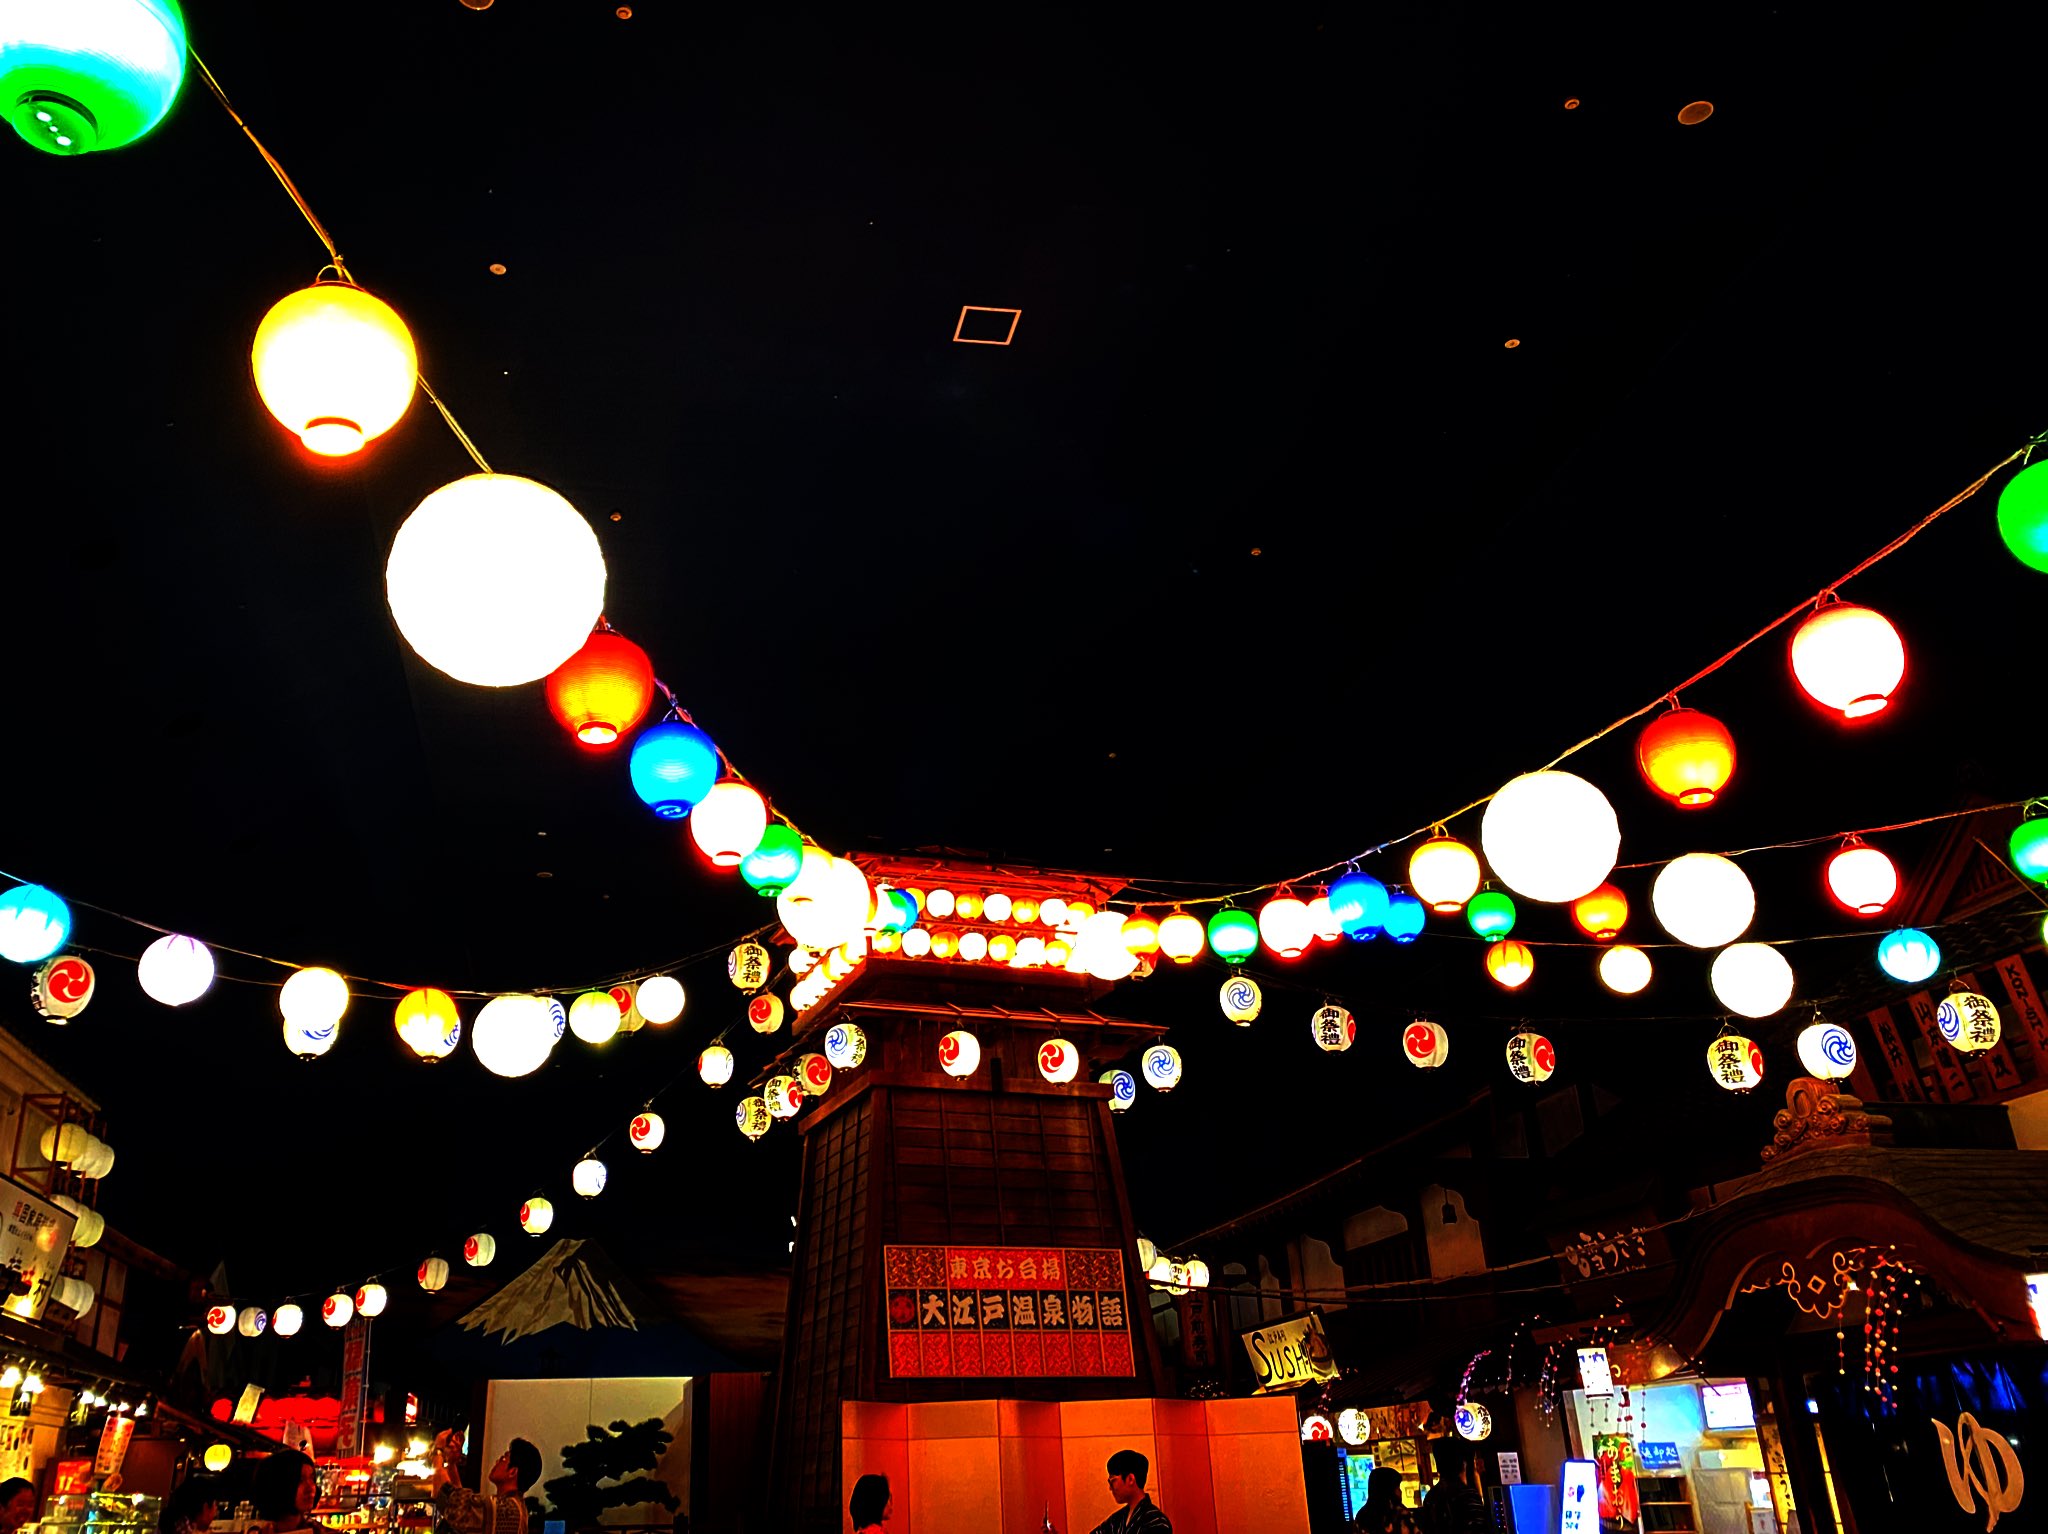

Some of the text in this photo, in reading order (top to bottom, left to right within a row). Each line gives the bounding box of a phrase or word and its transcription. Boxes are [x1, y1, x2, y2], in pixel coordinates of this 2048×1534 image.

[1963, 995, 1996, 1043] 御祭禮
[1715, 1039, 1747, 1084] 御祭禮
[950, 1256, 1061, 1281] 東京お台場
[922, 1294, 1123, 1327] 大江戸温泉物語
[1251, 1331, 1314, 1384] SUSHI
[1931, 1411, 2025, 1534] ゆ
